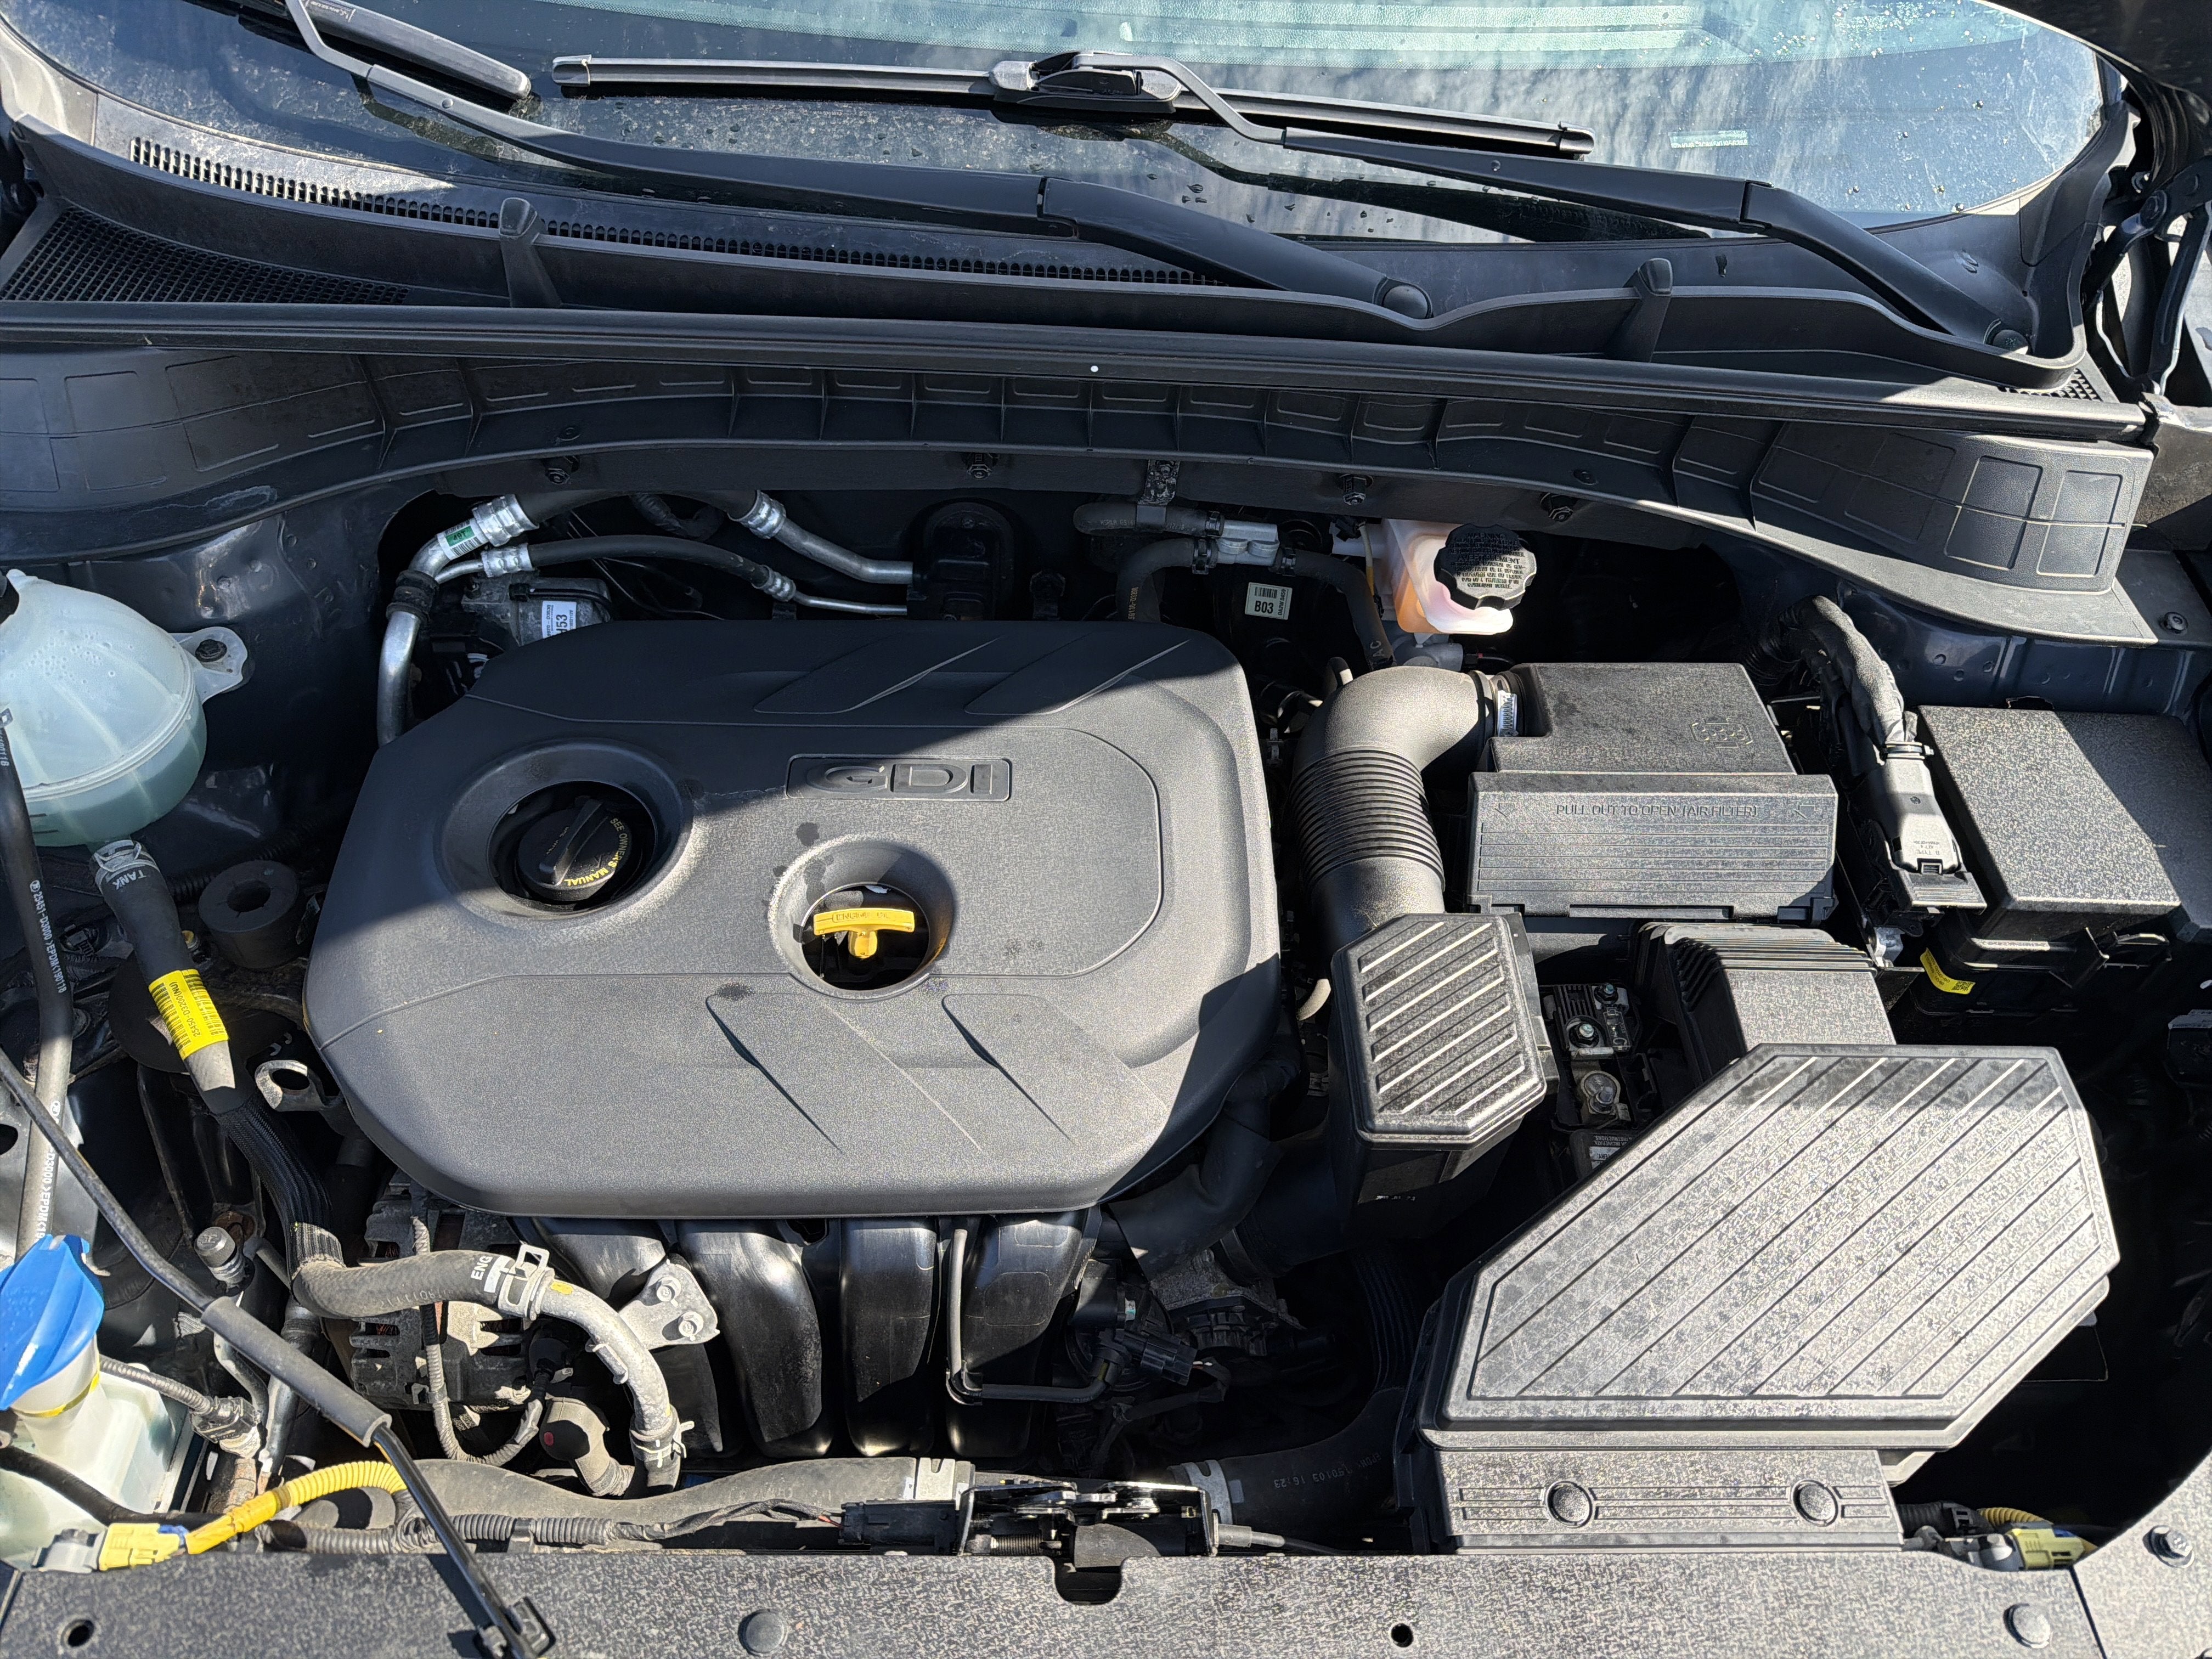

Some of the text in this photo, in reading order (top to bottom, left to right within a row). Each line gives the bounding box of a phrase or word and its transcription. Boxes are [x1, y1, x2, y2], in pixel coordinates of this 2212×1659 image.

[1255, 600, 1276, 614] B03
[806, 764, 994, 795] GDI
[1556, 804, 1590, 816] PULL
[1592, 804, 1618, 816] OUT
[1621, 804, 1639, 816] TO
[1641, 804, 1677, 817] OPEN
[564, 817, 628, 887] SEE OWNER'S MANUAL
[116, 870, 148, 891] TANK
[169, 981, 201, 1037] 25450-D3200(NU)
[470, 1256, 493, 1280] ENG
